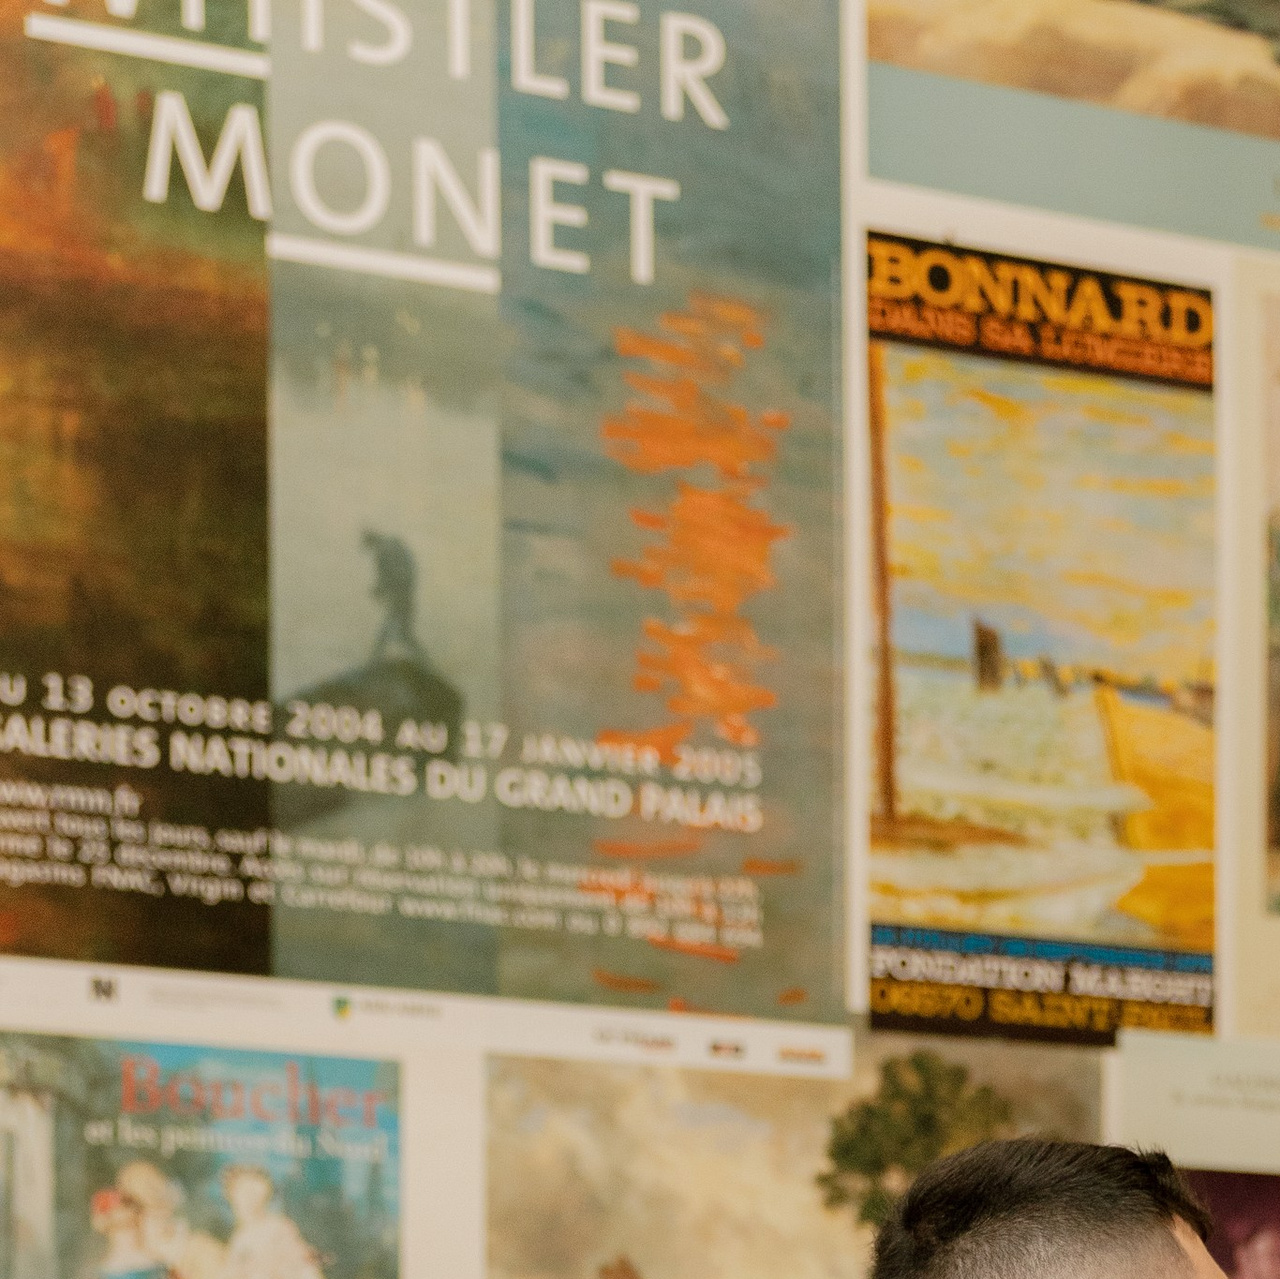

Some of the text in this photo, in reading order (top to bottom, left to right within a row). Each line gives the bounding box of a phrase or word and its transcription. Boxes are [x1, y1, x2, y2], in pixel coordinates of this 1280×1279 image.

[35, 0, 732, 130] STLER
[143, 90, 683, 286] MONET
[867, 238, 1213, 345] BONNARD
[42, 672, 94, 713] 13
[107, 685, 272, 735] OCTOBRE
[287, 699, 384, 745] 2004
[395, 718, 448, 754] AU
[462, 719, 509, 761] 17
[520, 734, 661, 777] JANVIER
[672, 742, 763, 789] 2005
[169, 729, 418, 797] NATIONALES
[425, 758, 487, 804] DU
[494, 766, 634, 820] GRAND
[639, 782, 764, 834] PALAIS
[167, 870, 245, 906] Virgin
[871, 945, 1068, 996] FONDATION
[83, 1120, 115, 1146] et
[117, 1115, 158, 1148] les
[121, 1053, 388, 1129] Boucher
